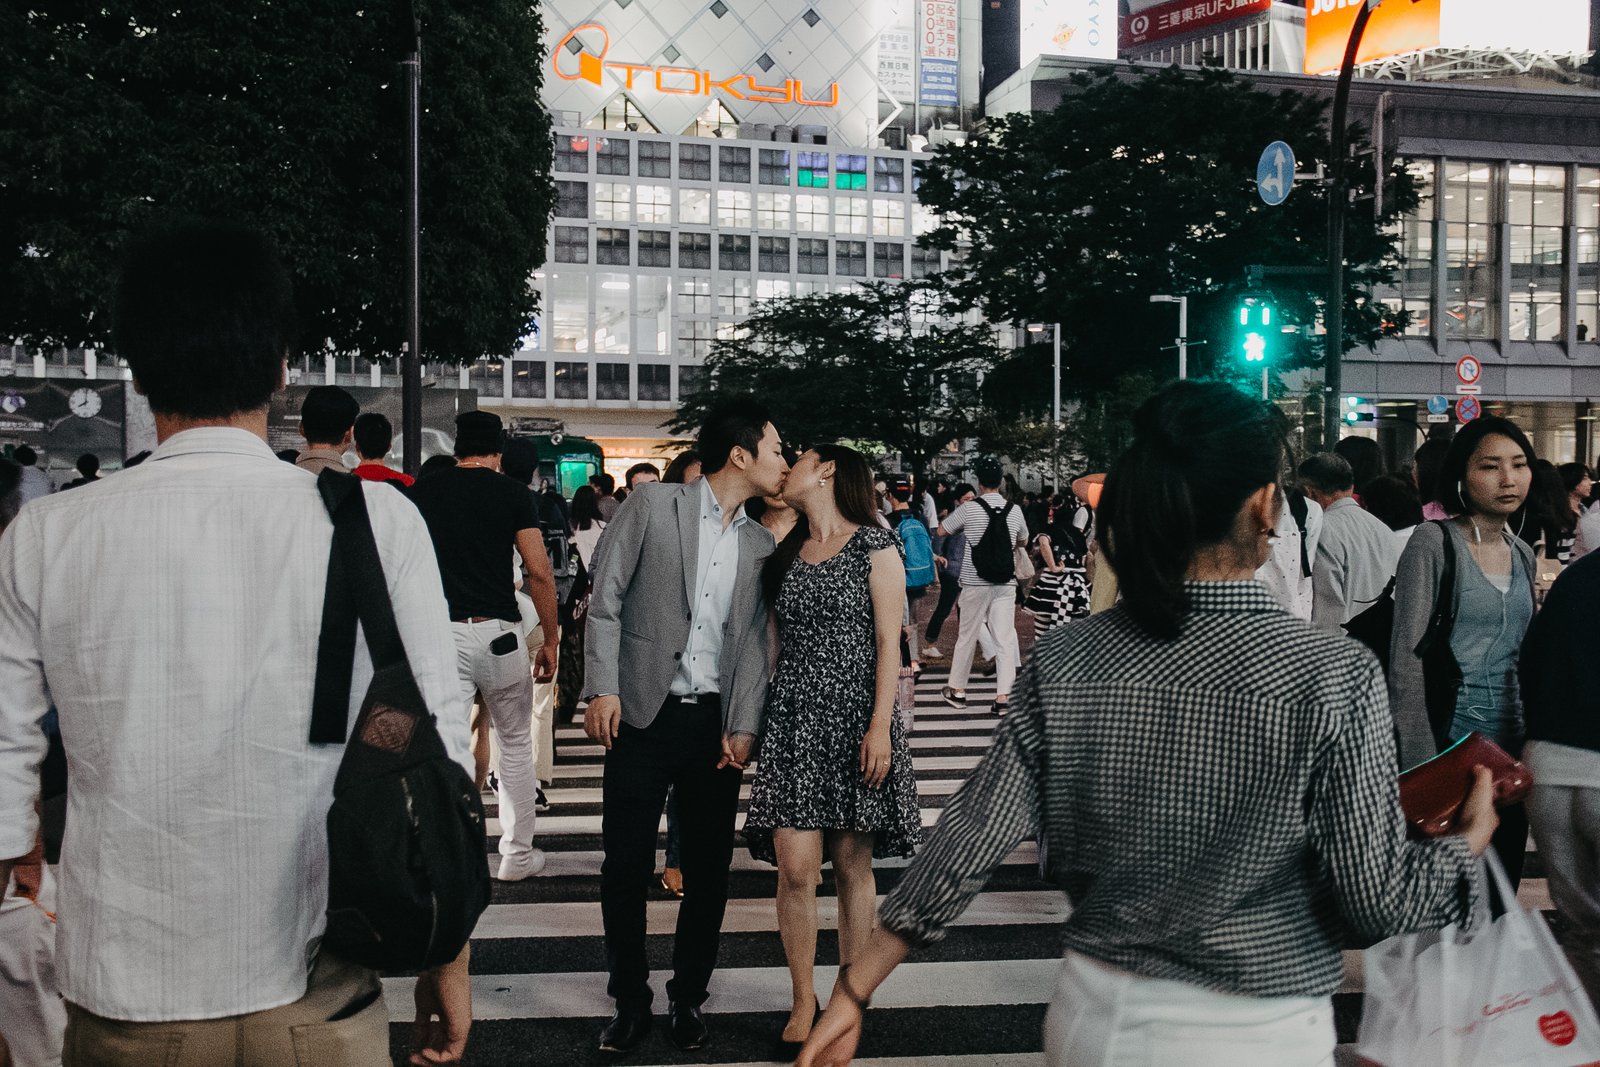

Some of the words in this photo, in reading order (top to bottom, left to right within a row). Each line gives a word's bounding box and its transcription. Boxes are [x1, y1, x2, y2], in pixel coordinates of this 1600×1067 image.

[1158, 0, 1260, 30] 三菱東京UFJ
[604, 61, 839, 107] TOKYU
